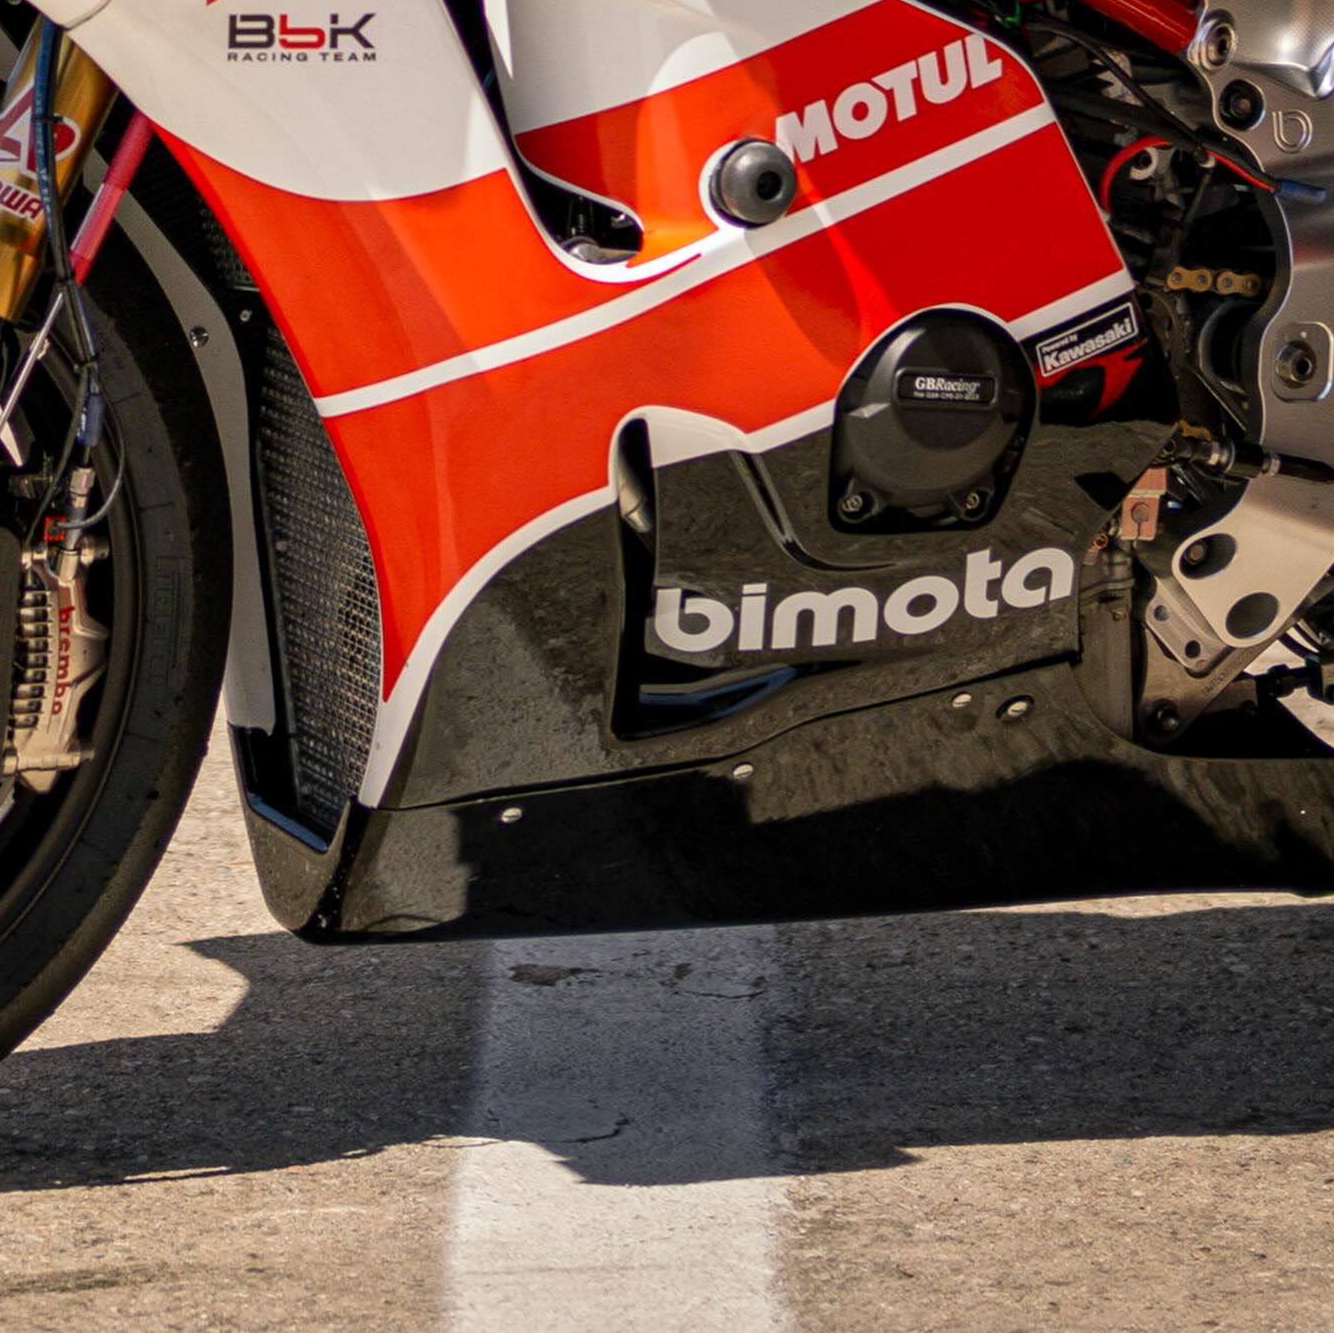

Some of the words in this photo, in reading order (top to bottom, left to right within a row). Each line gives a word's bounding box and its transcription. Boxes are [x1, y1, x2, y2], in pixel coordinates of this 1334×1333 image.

[227, 52, 308, 62] RACING
[320, 52, 378, 62] TEAM
[773, 31, 1004, 167] MOTUL
[1043, 317, 1133, 372] Kawasaki
[655, 546, 1075, 652] bimota
[51, 604, 76, 716] brembo
